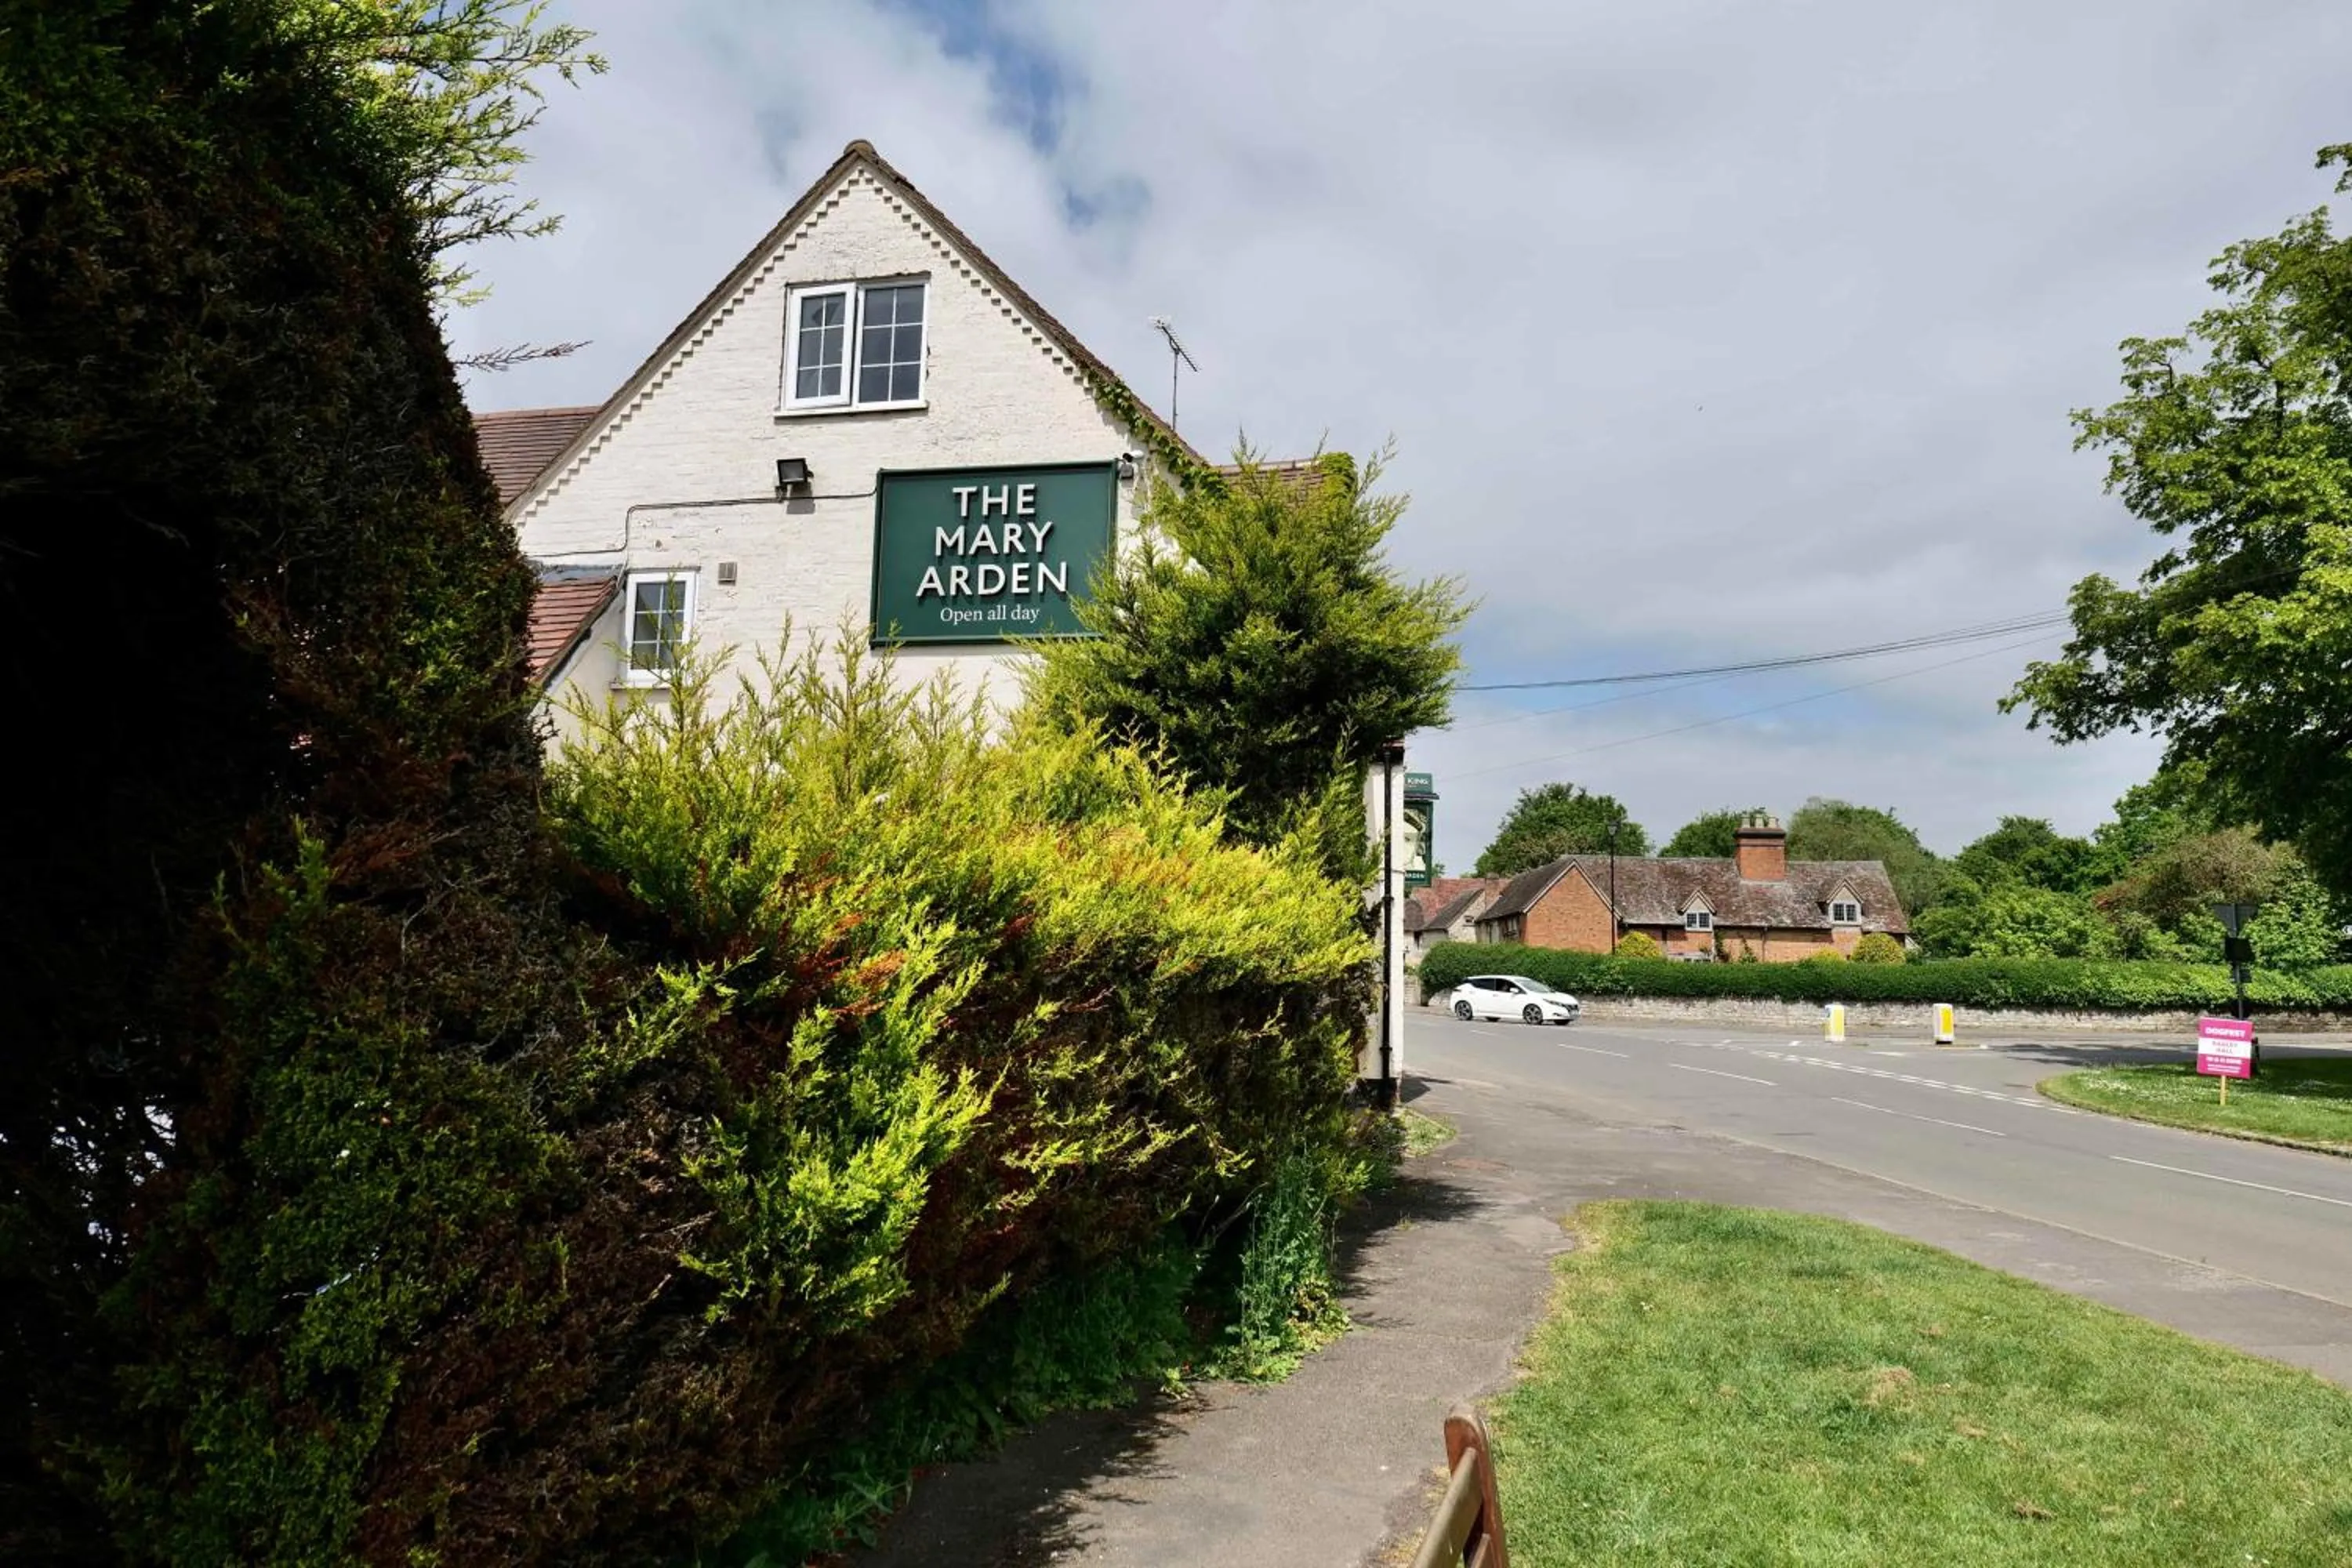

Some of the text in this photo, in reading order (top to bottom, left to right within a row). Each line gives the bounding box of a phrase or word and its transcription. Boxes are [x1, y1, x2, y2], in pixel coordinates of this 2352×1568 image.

[953, 483, 1036, 517] THE
[935, 521, 1054, 557] MARY
[916, 561, 1068, 597] ARDEN
[940, 603, 1040, 626] Open all day
